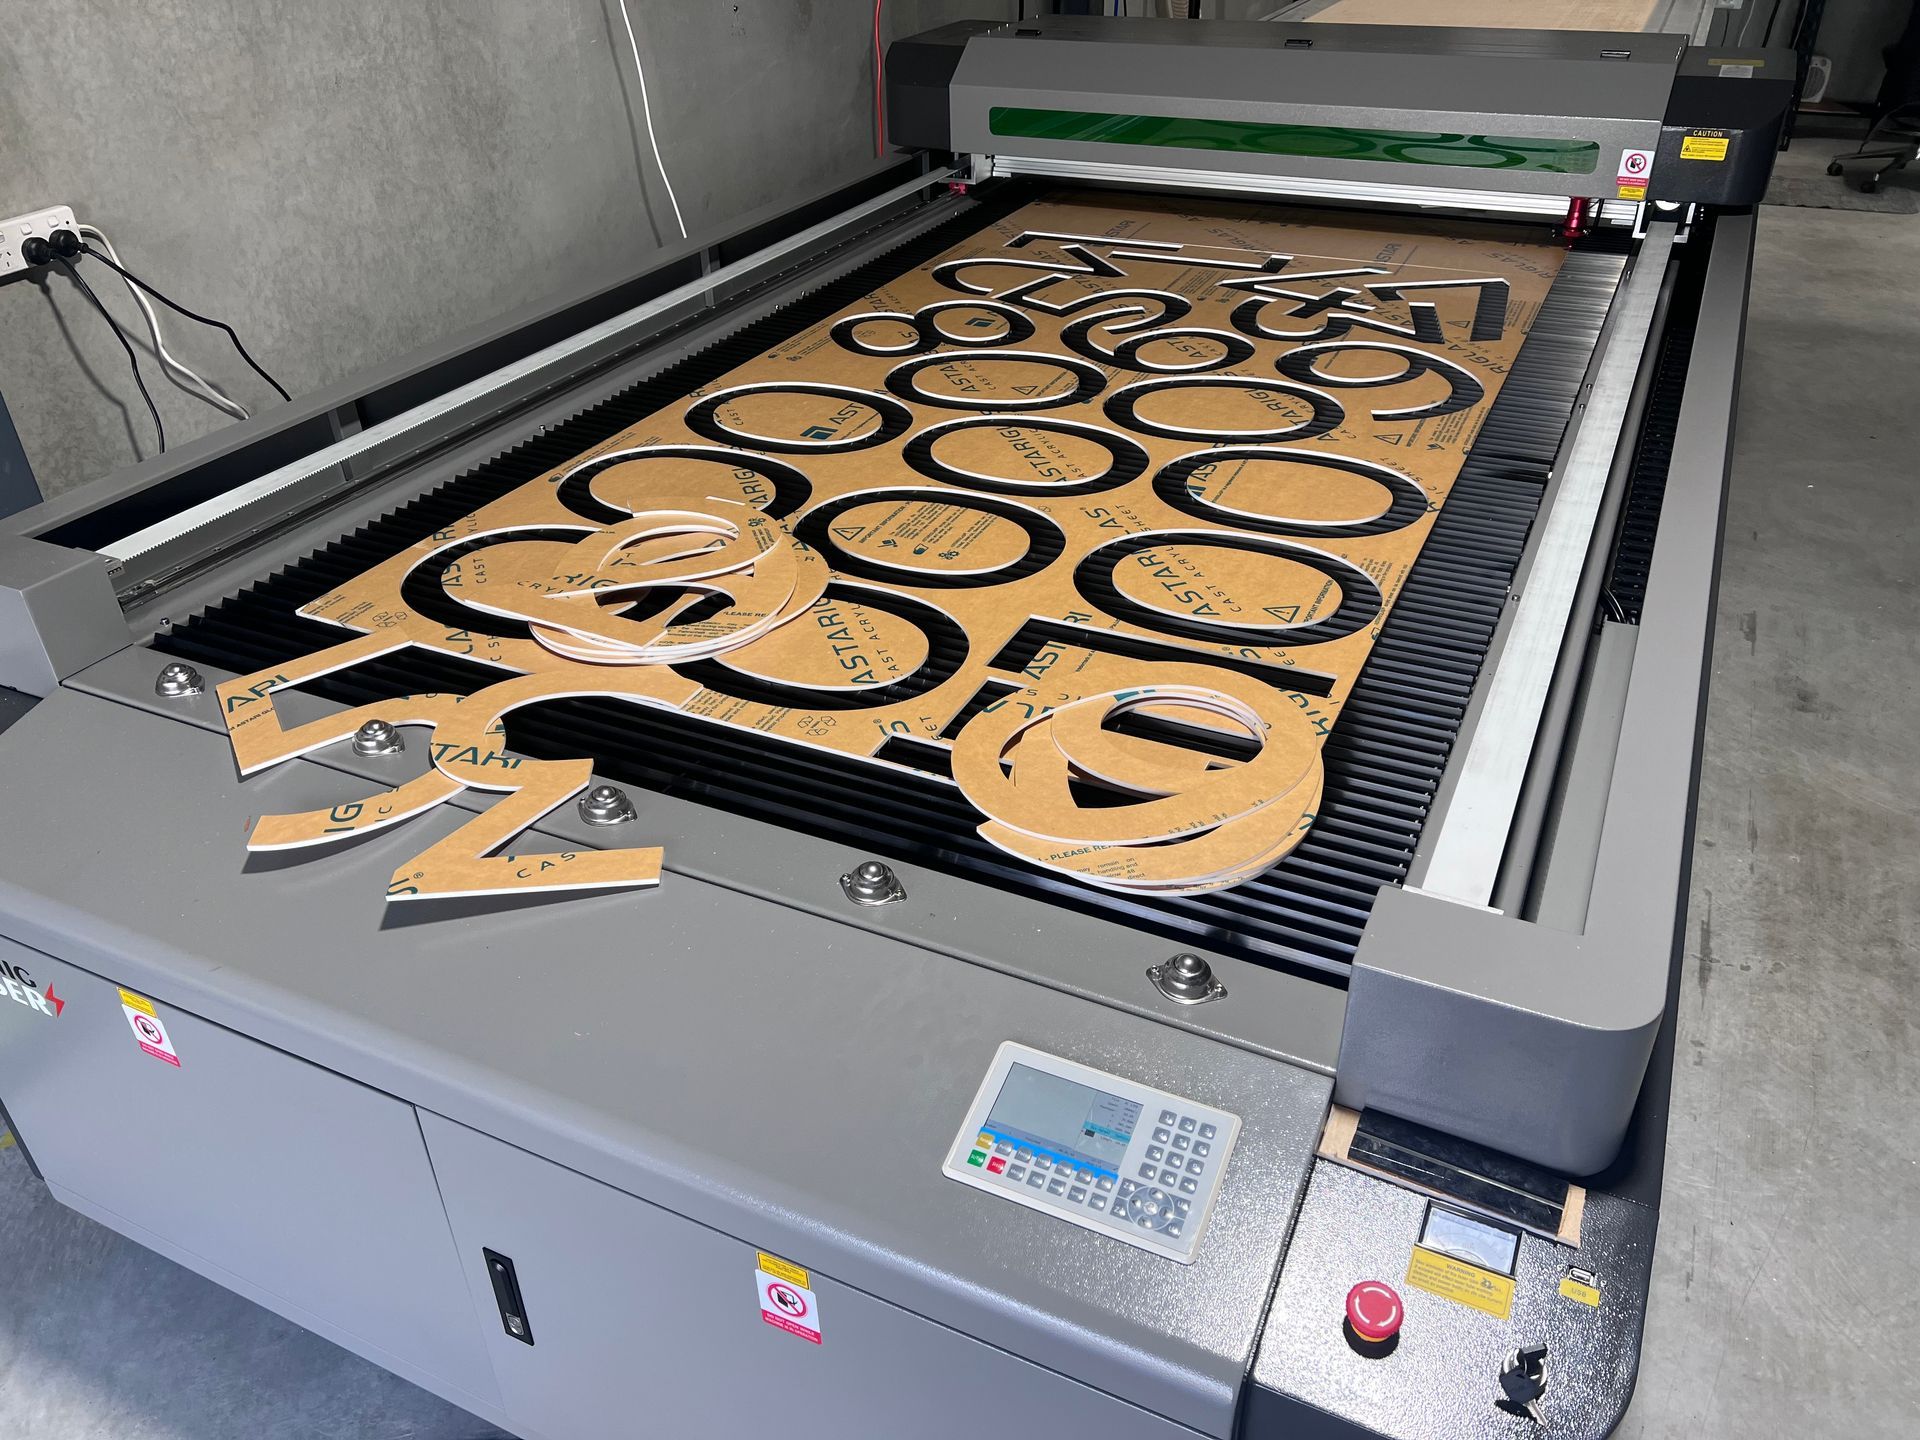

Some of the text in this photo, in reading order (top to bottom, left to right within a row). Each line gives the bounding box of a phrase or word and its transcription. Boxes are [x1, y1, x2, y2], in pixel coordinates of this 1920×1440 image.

[1446, 342, 1509, 374] RIGLA
[473, 558, 488, 584] CAST
[1205, 584, 1243, 613] CAST
[516, 852, 576, 879] CAS
[1050, 846, 1093, 861] PLEASE
[1446, 1263, 1476, 1278] WARNING
